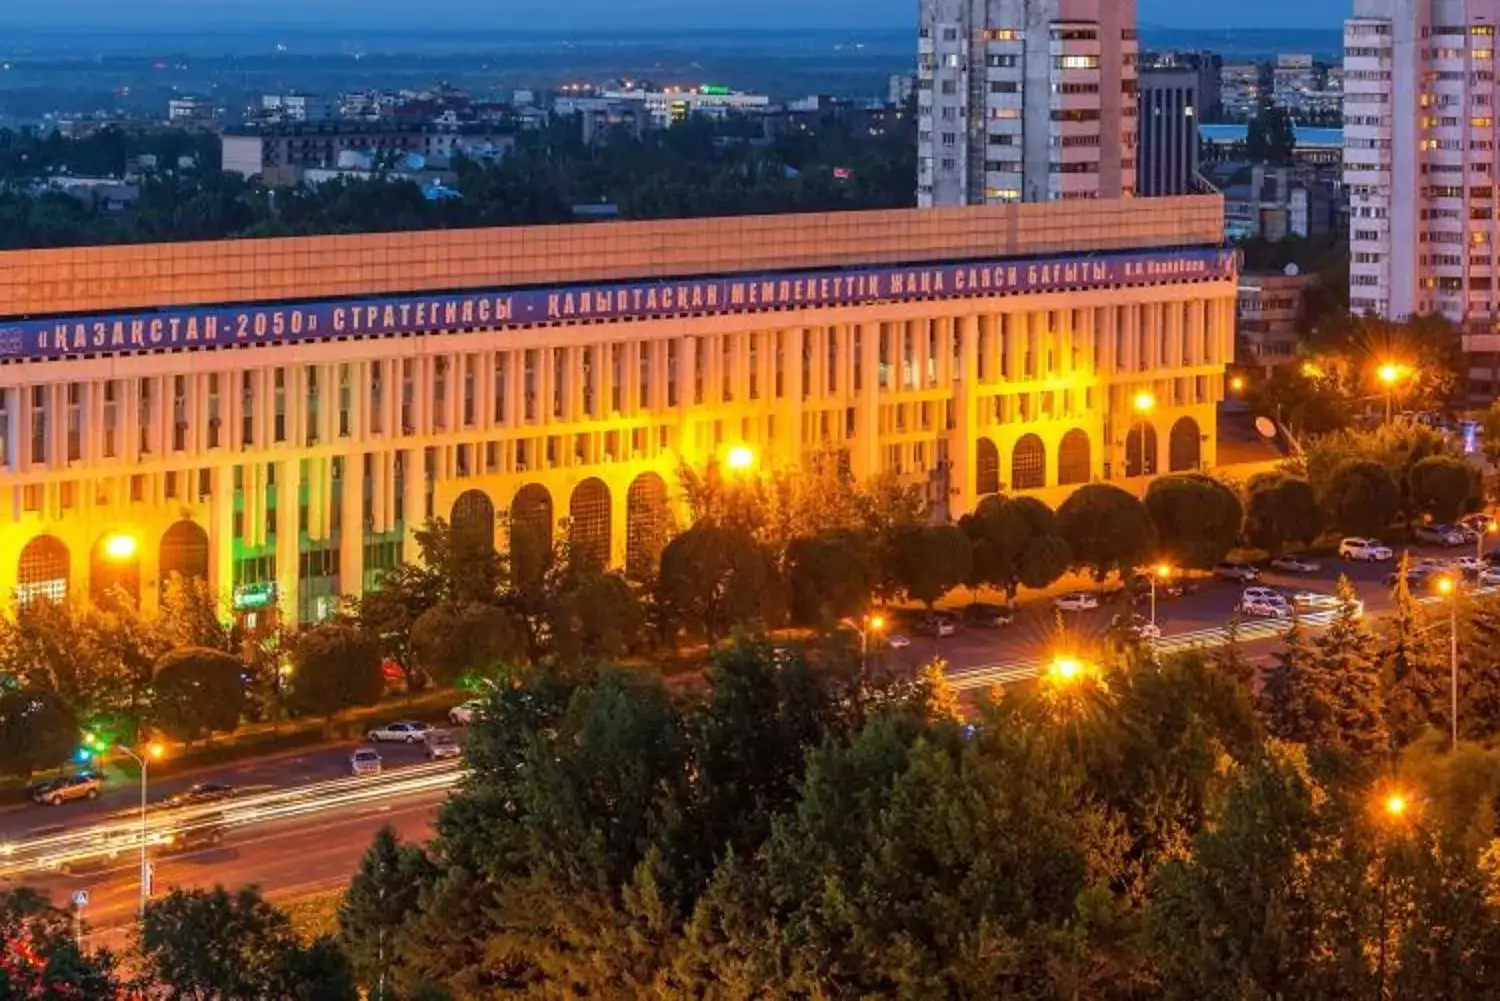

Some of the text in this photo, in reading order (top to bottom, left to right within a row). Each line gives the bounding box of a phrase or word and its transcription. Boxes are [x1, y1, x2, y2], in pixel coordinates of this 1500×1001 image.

[333, 298, 513, 331] СТРАТЕГИЯСЫ
[547, 283, 718, 318] ҚАЛЫПТАСҚАН
[730, 274, 879, 304] МЕМЛЕКЕТТІҢ
[890, 269, 944, 295] ЖАҢА
[955, 265, 1017, 290] САЯСИ
